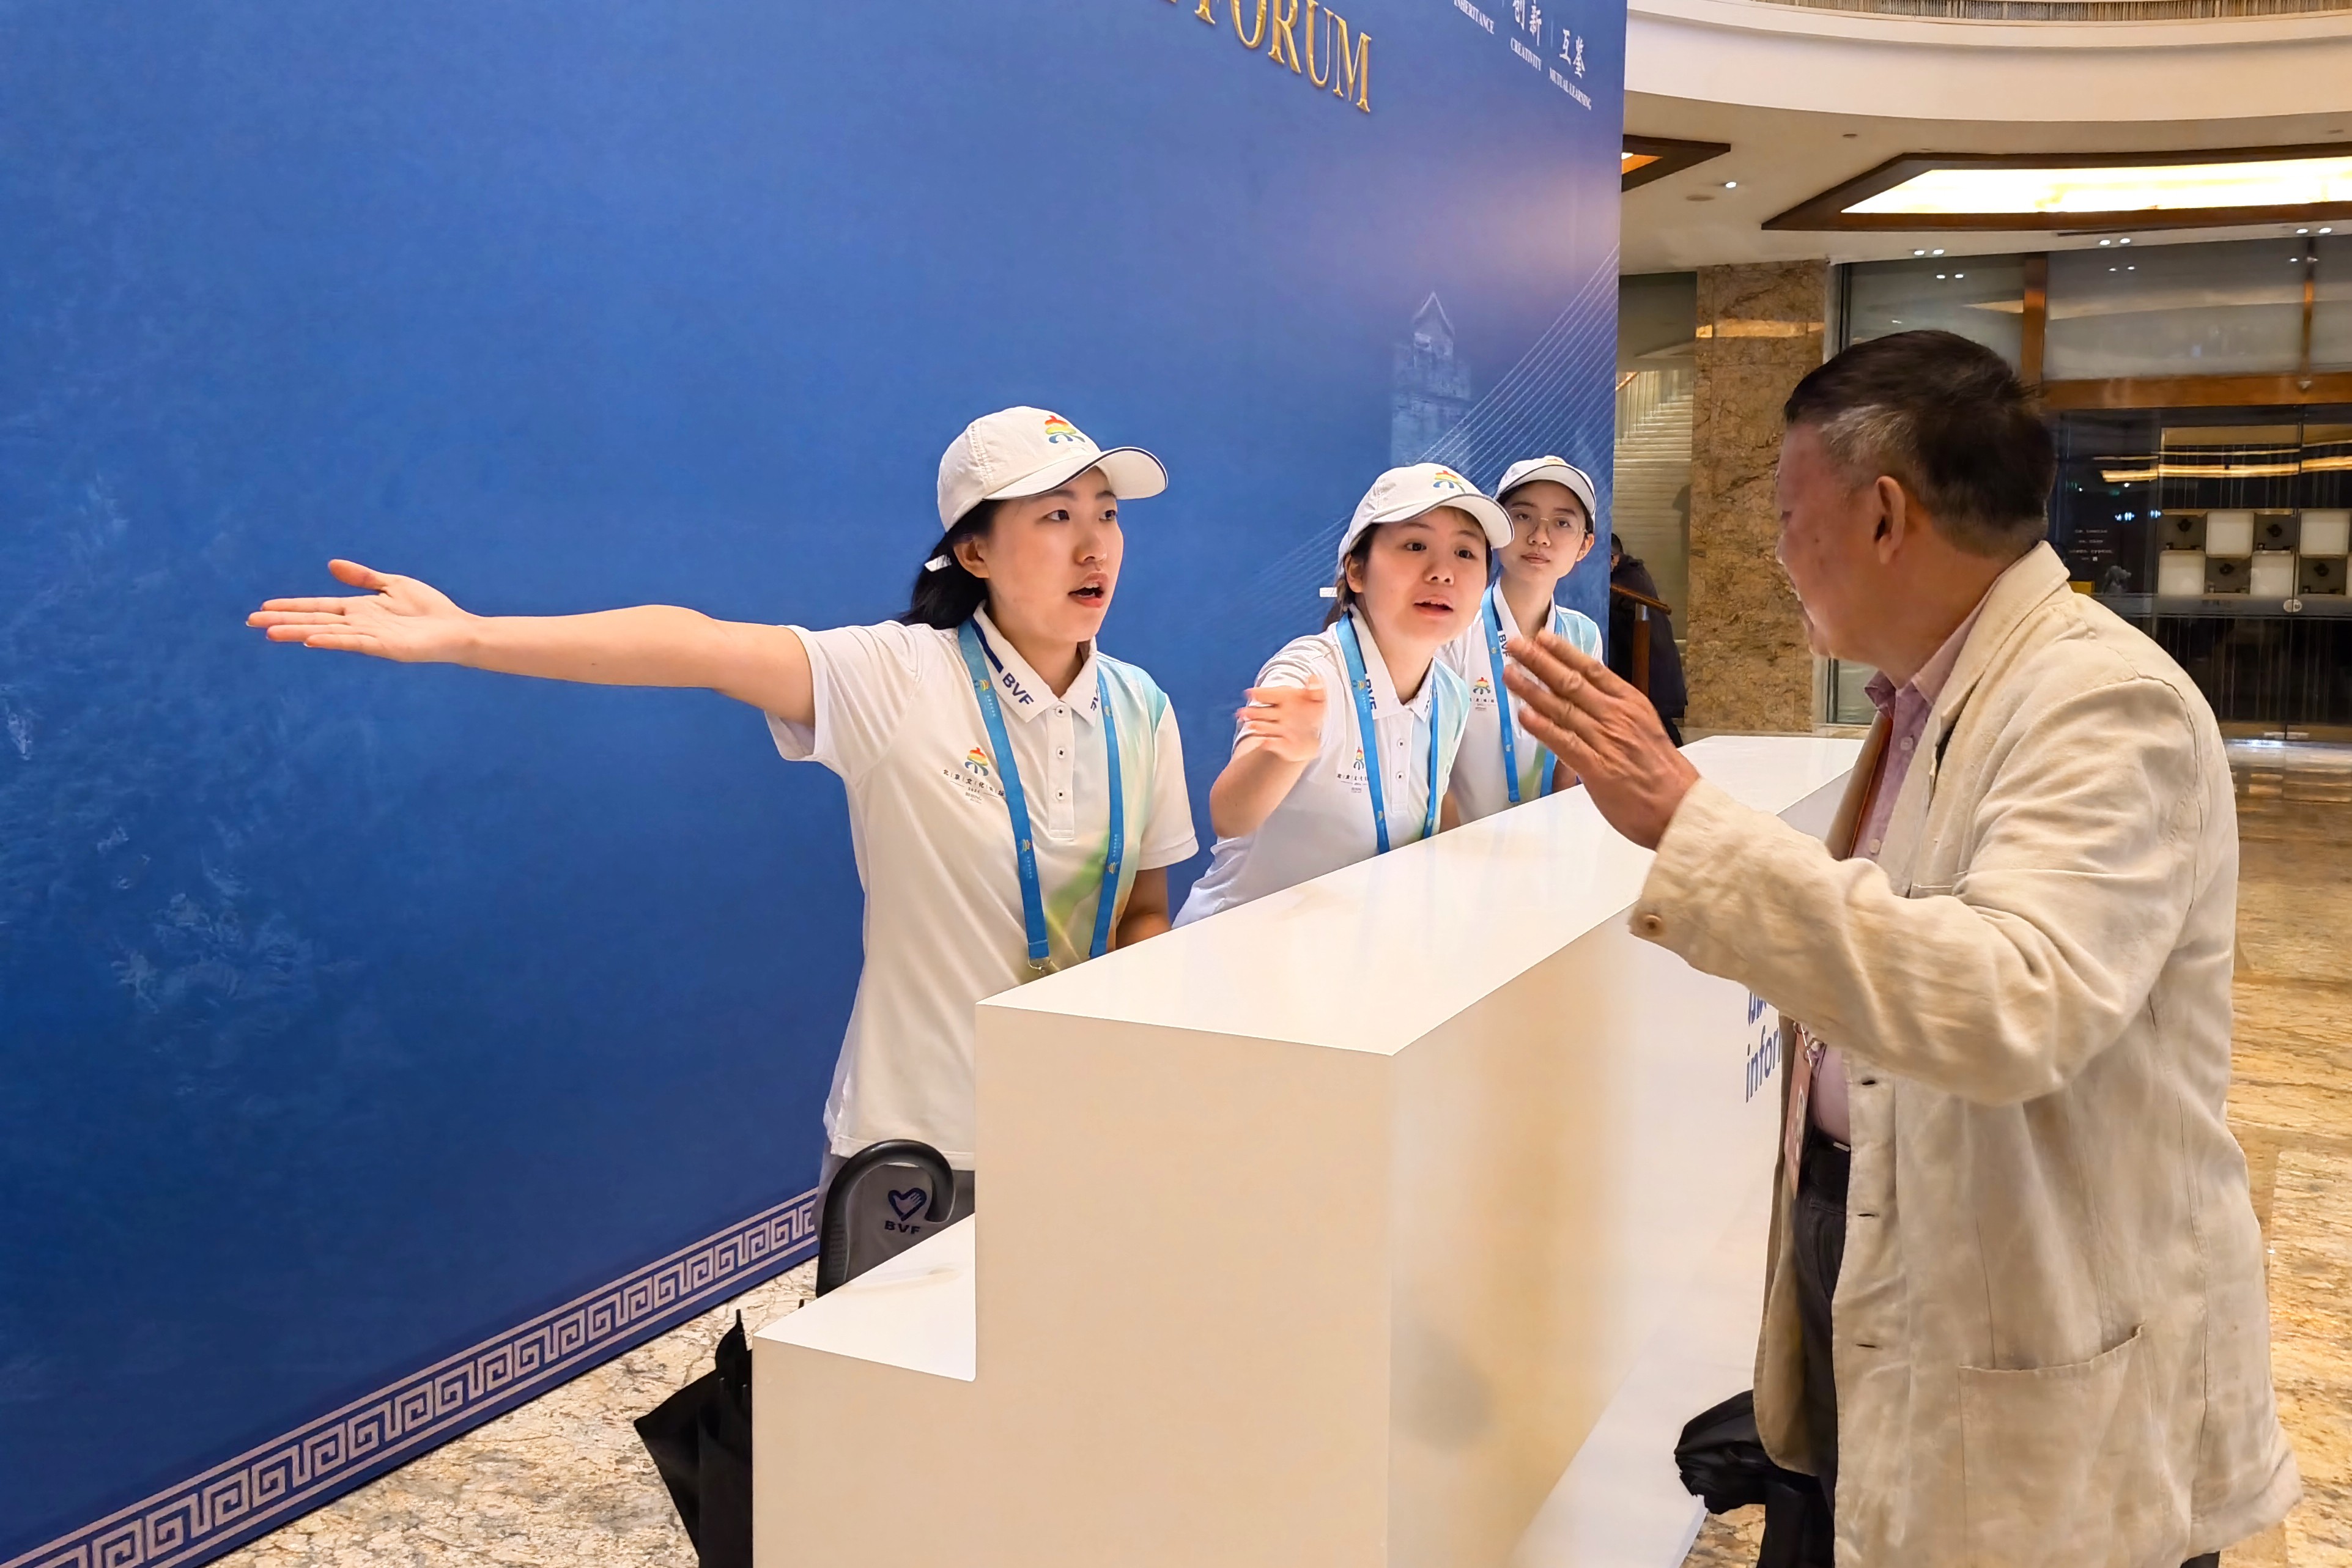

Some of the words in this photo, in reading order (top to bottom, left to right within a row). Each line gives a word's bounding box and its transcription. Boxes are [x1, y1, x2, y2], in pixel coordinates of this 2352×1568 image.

[1512, 0, 1542, 46] 创新
[1510, 37, 1542, 71] CREATIVITY
[1559, 29, 1585, 78] 互鉴
[1002, 672, 1034, 704] BVF
[884, 1220, 920, 1235] BVF
